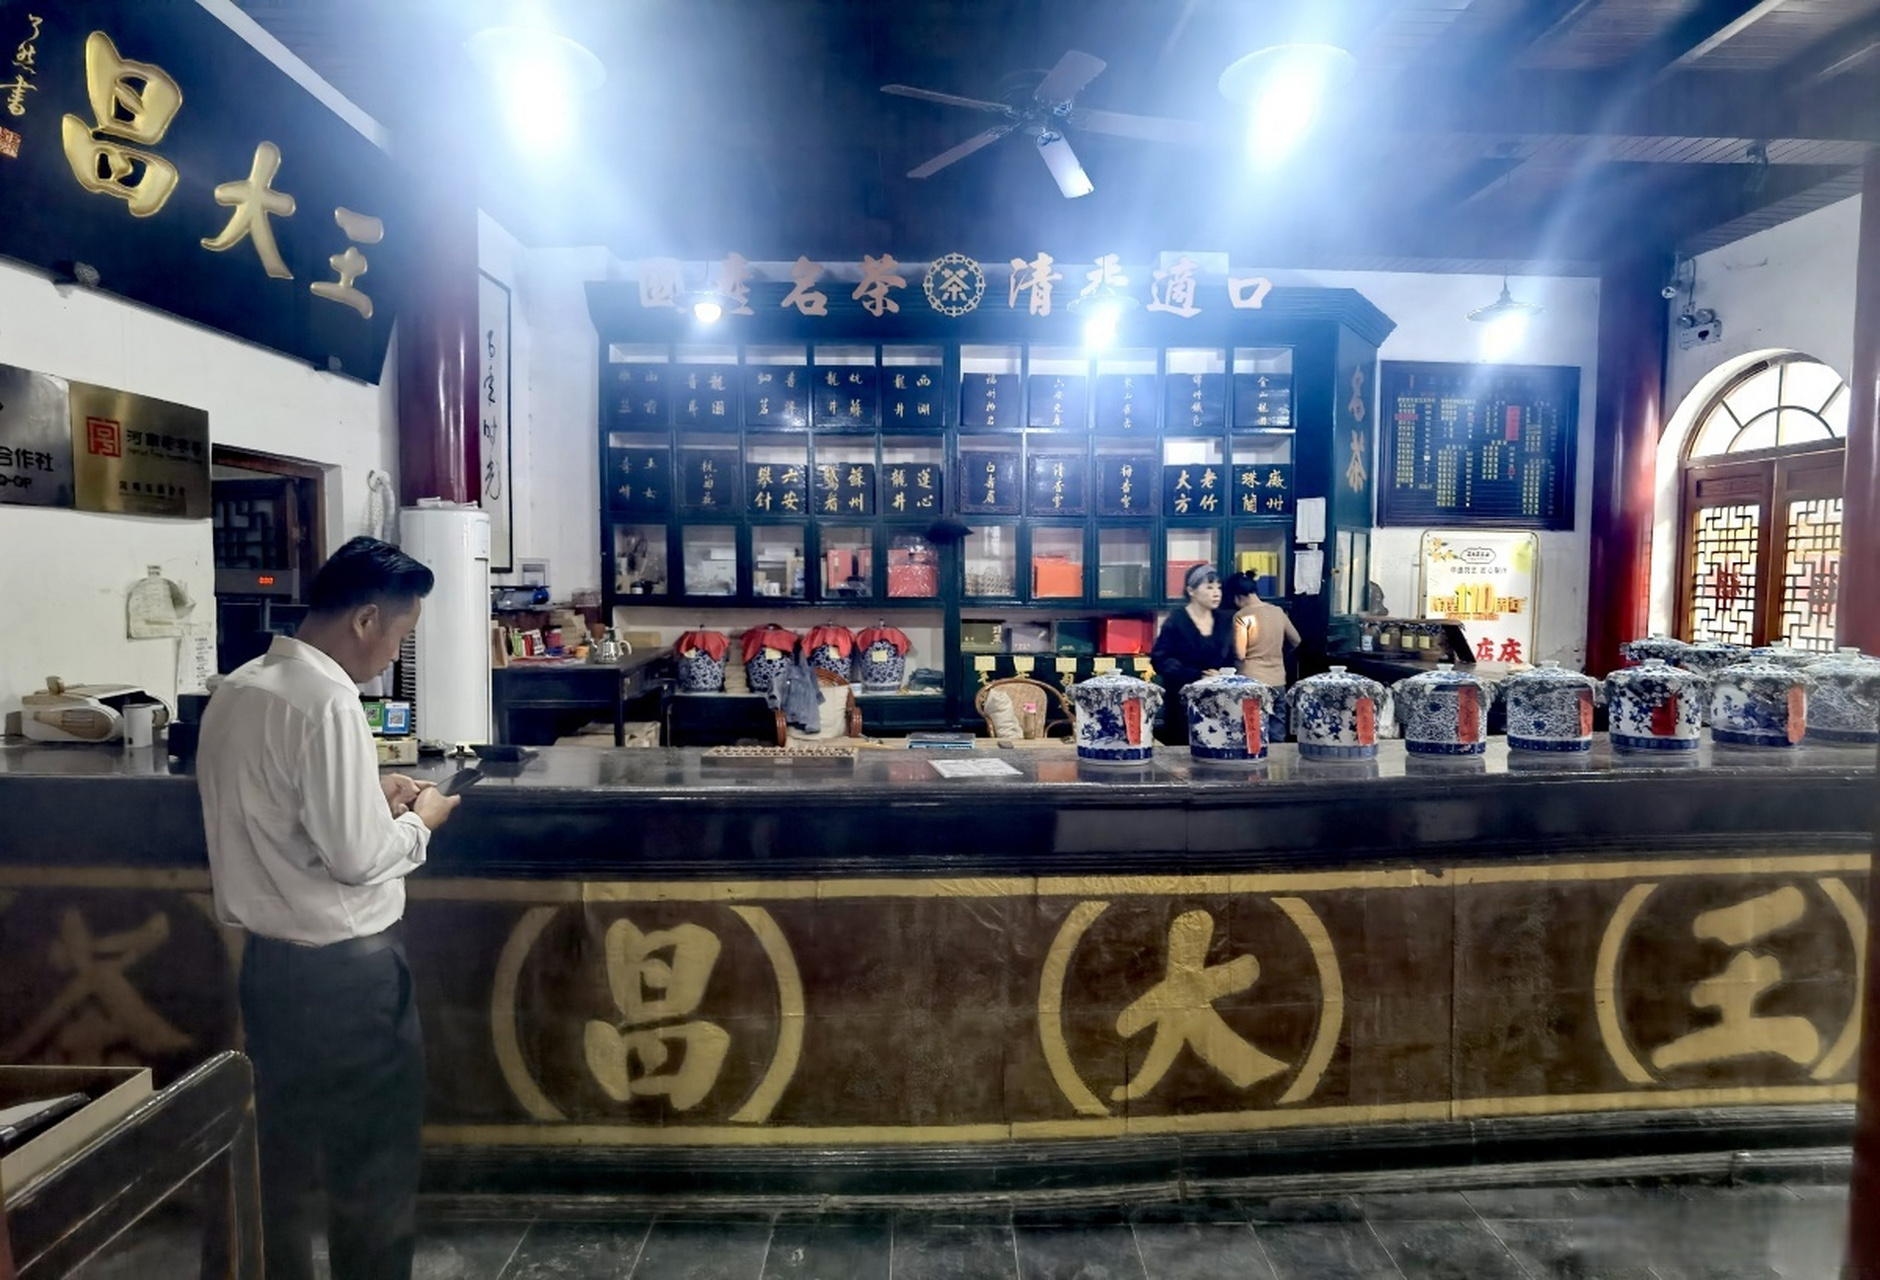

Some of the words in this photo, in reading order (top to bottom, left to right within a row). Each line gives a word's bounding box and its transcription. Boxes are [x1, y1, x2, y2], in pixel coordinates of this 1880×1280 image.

[781, 467, 800, 511] 六安
[1174, 469, 1193, 513] 大方
[1199, 467, 1218, 512] 老竹
[1475, 637, 1523, 664] 店庆
[1650, 885, 1820, 1070] 王
[584, 918, 731, 1111] 昌
[1110, 909, 1290, 1102] 大
